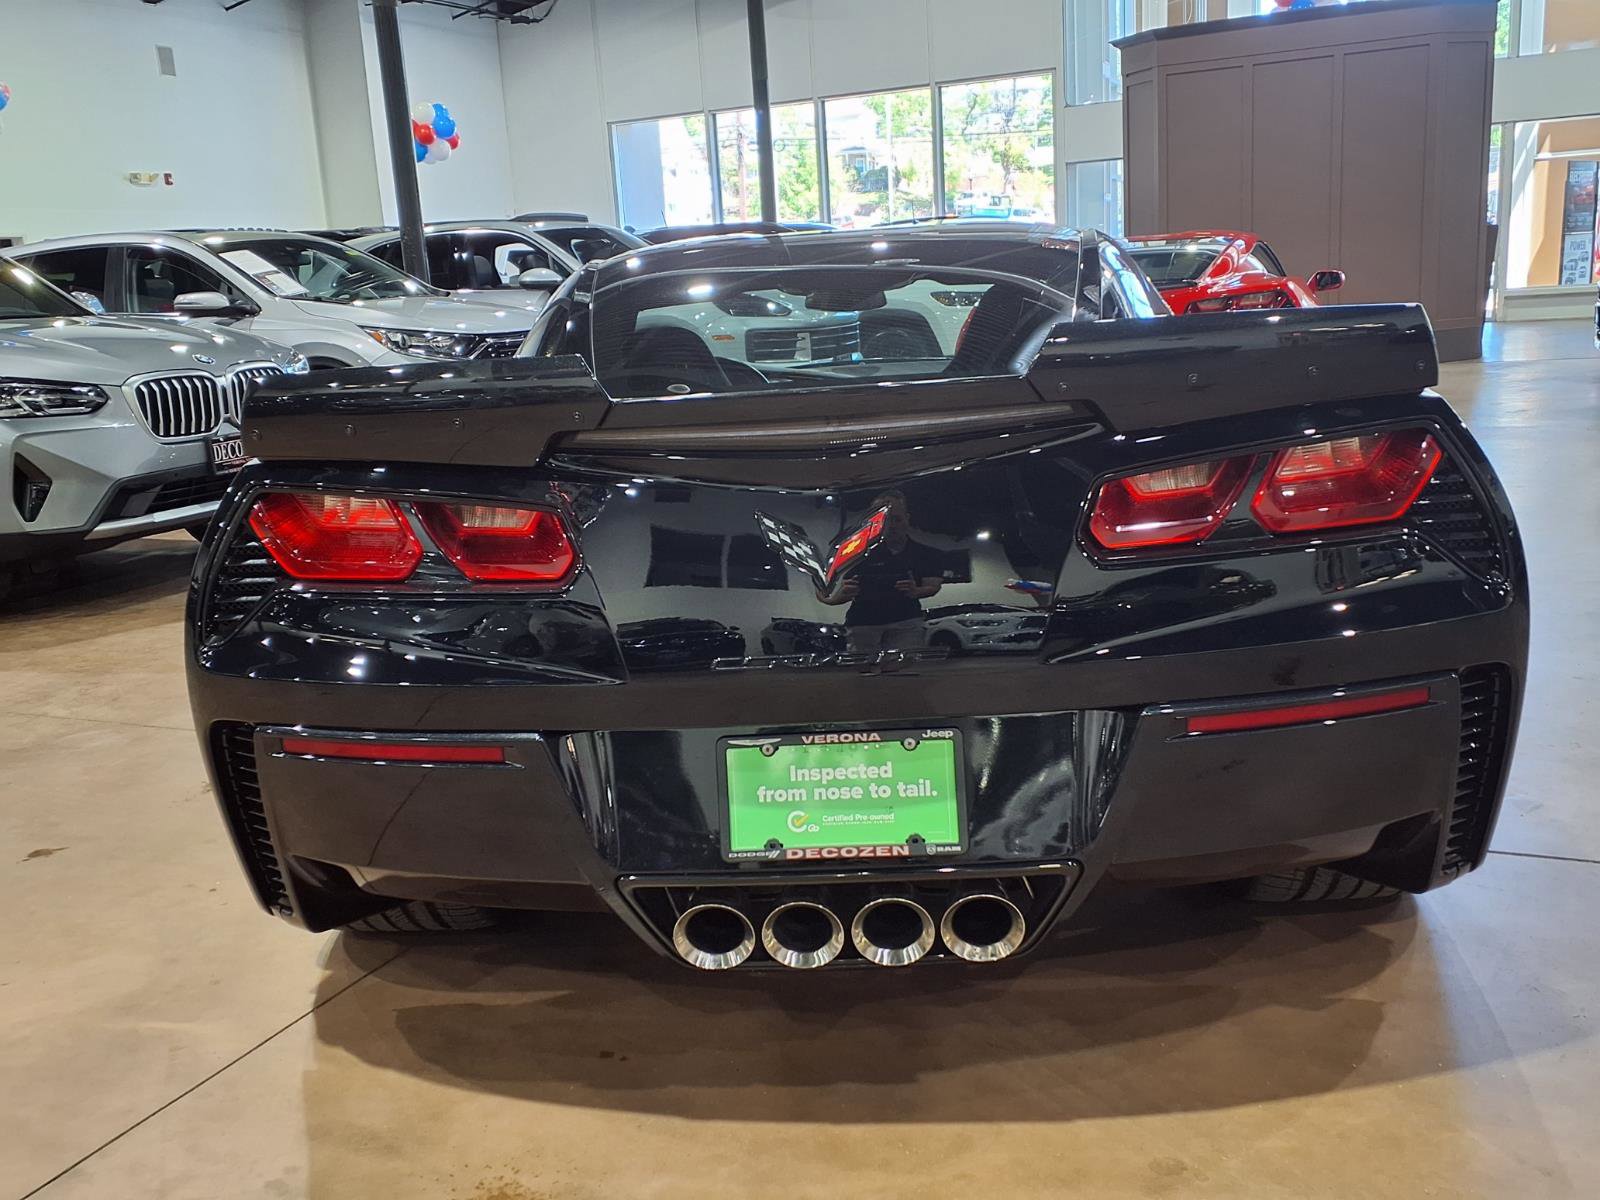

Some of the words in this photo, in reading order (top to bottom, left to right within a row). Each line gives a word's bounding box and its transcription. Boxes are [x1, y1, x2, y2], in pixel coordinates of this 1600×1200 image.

[213, 441, 243, 461] DECO
[801, 732, 881, 744] VERONA
[921, 729, 954, 738] Jeep
[789, 761, 893, 784] Inspected
[757, 786, 807, 802] from
[813, 786, 864, 800] nose
[868, 782, 892, 798] to
[896, 779, 938, 797] tail.
[822, 813, 854, 822] Certified
[786, 845, 909, 859] DECOZEN
